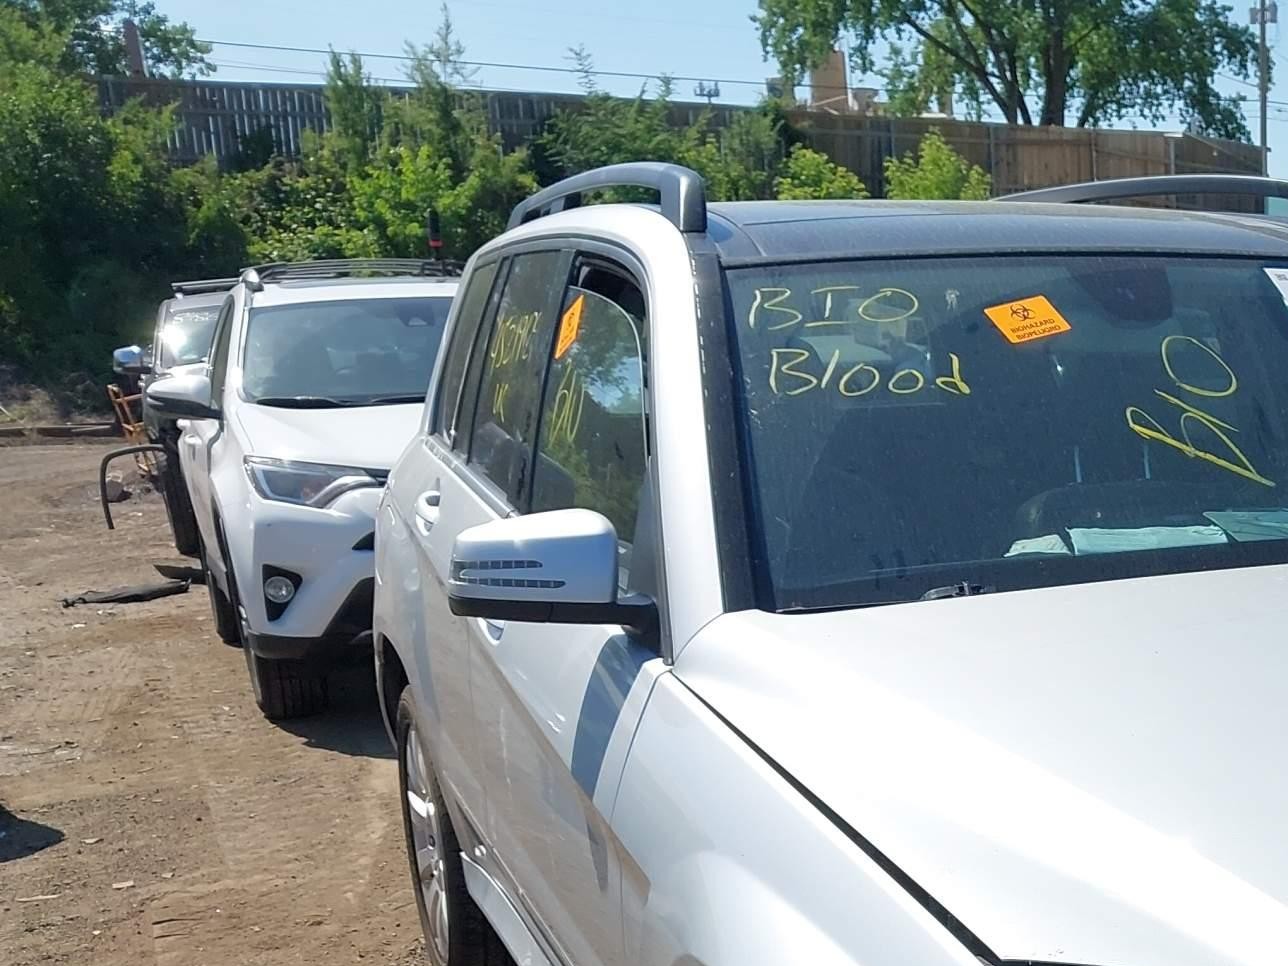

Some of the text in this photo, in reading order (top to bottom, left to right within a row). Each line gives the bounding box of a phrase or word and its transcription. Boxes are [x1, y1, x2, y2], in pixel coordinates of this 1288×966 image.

[749, 286, 919, 330] BIO
[1010, 318, 1055, 333] BIOHAZARD
[769, 348, 971, 396] Blood
